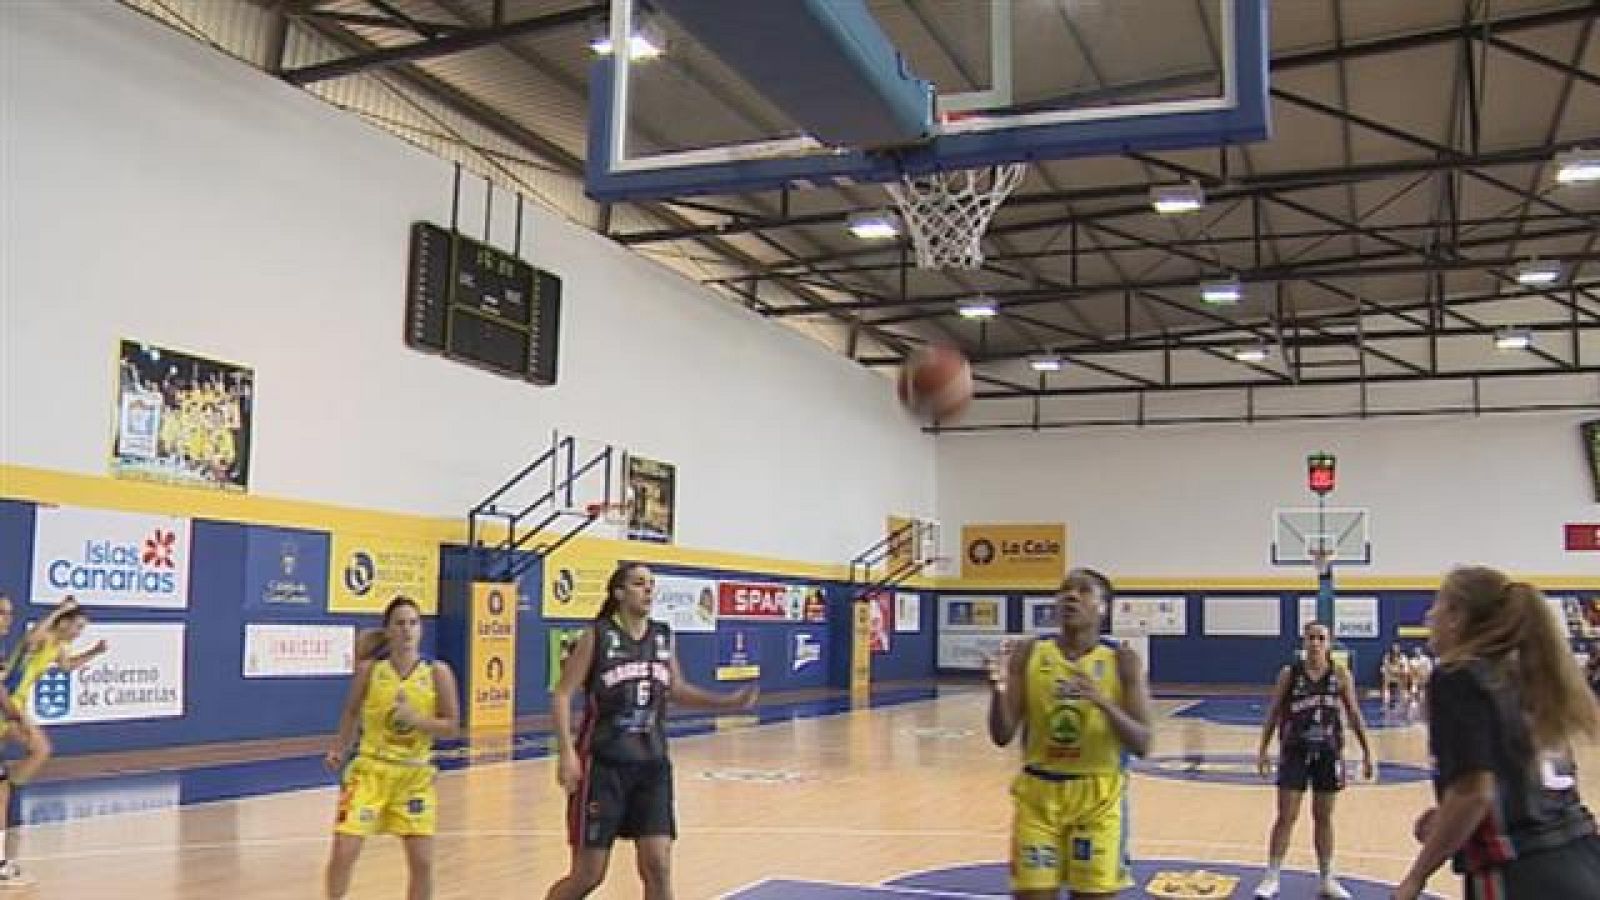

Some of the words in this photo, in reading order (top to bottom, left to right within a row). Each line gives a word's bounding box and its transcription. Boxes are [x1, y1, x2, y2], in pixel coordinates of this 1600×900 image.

[85, 540, 139, 566] Islas
[1002, 540, 1020, 555] La
[48, 560, 175, 593] Canarias
[734, 588, 785, 613] SPAR
[78, 665, 160, 684] Gobierno
[78, 687, 100, 708] de
[103, 684, 177, 706] Canarias
